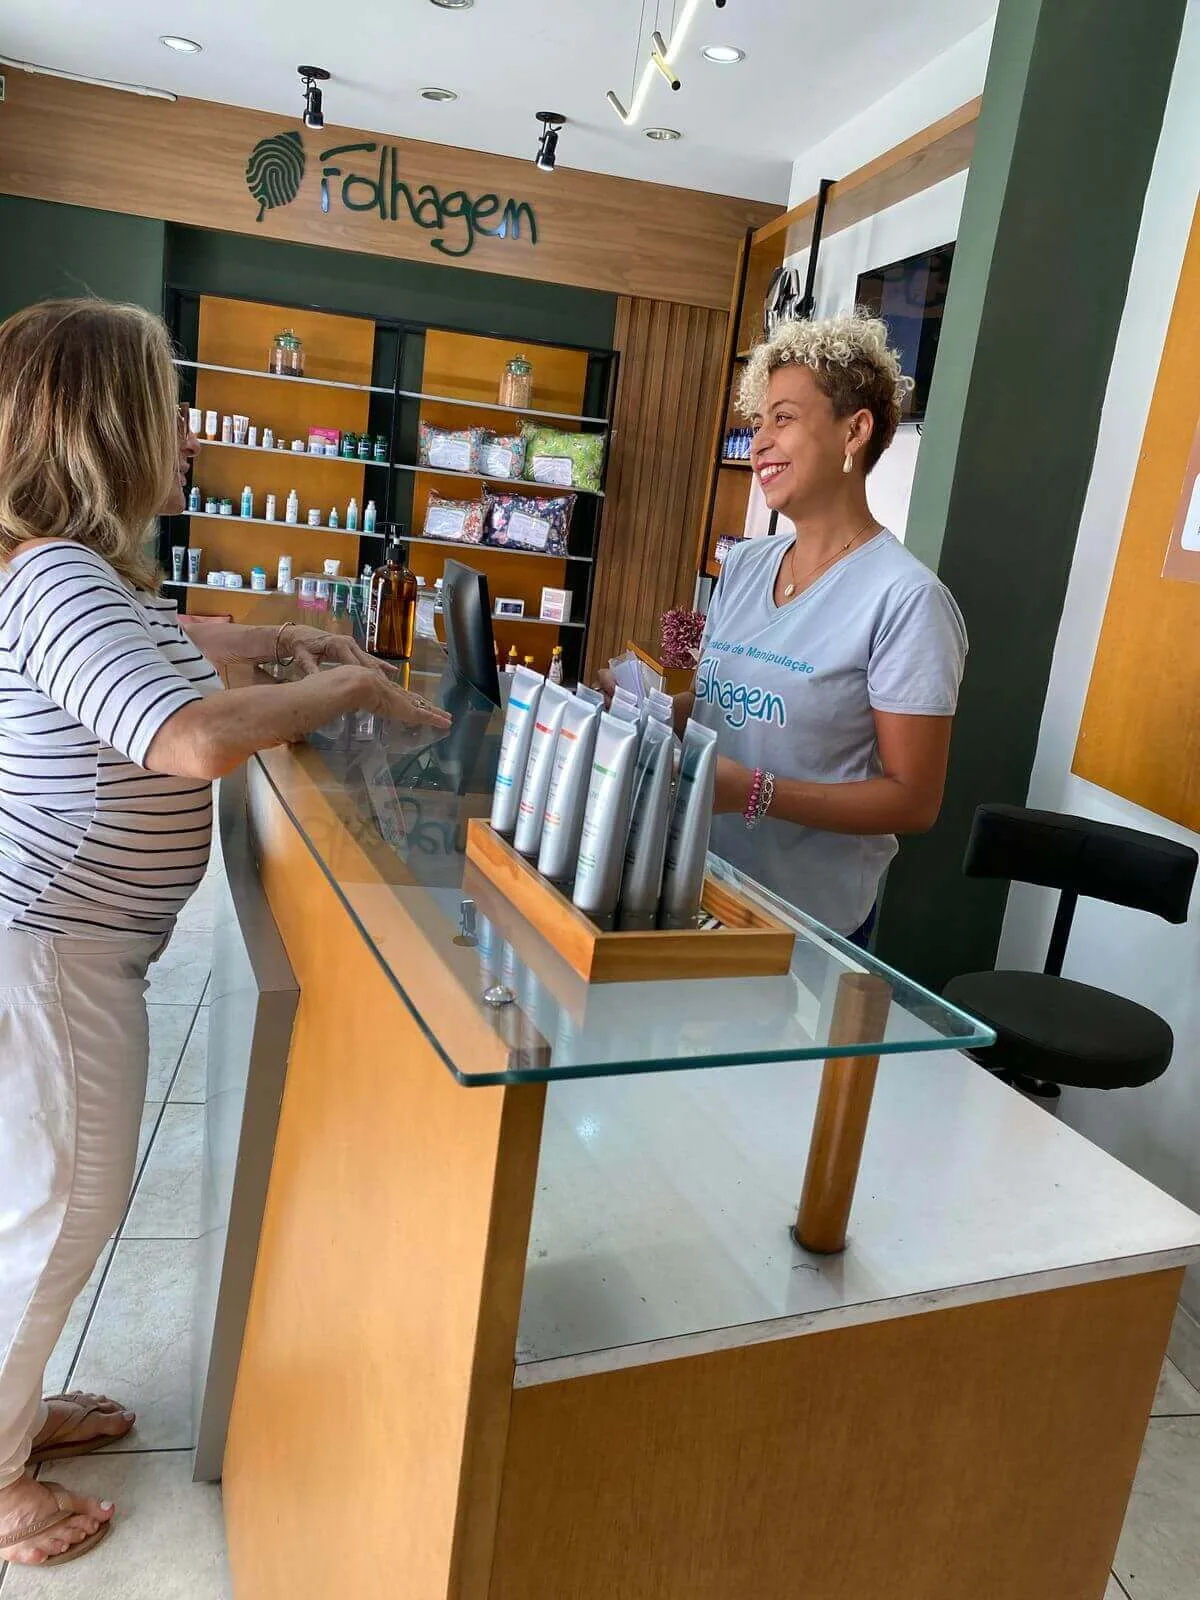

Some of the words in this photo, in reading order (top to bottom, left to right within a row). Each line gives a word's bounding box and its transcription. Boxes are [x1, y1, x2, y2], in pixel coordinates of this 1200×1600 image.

[319, 142, 538, 257] Folhagem
[731, 645, 744, 655] de
[746, 646, 814, 674] Manipulação
